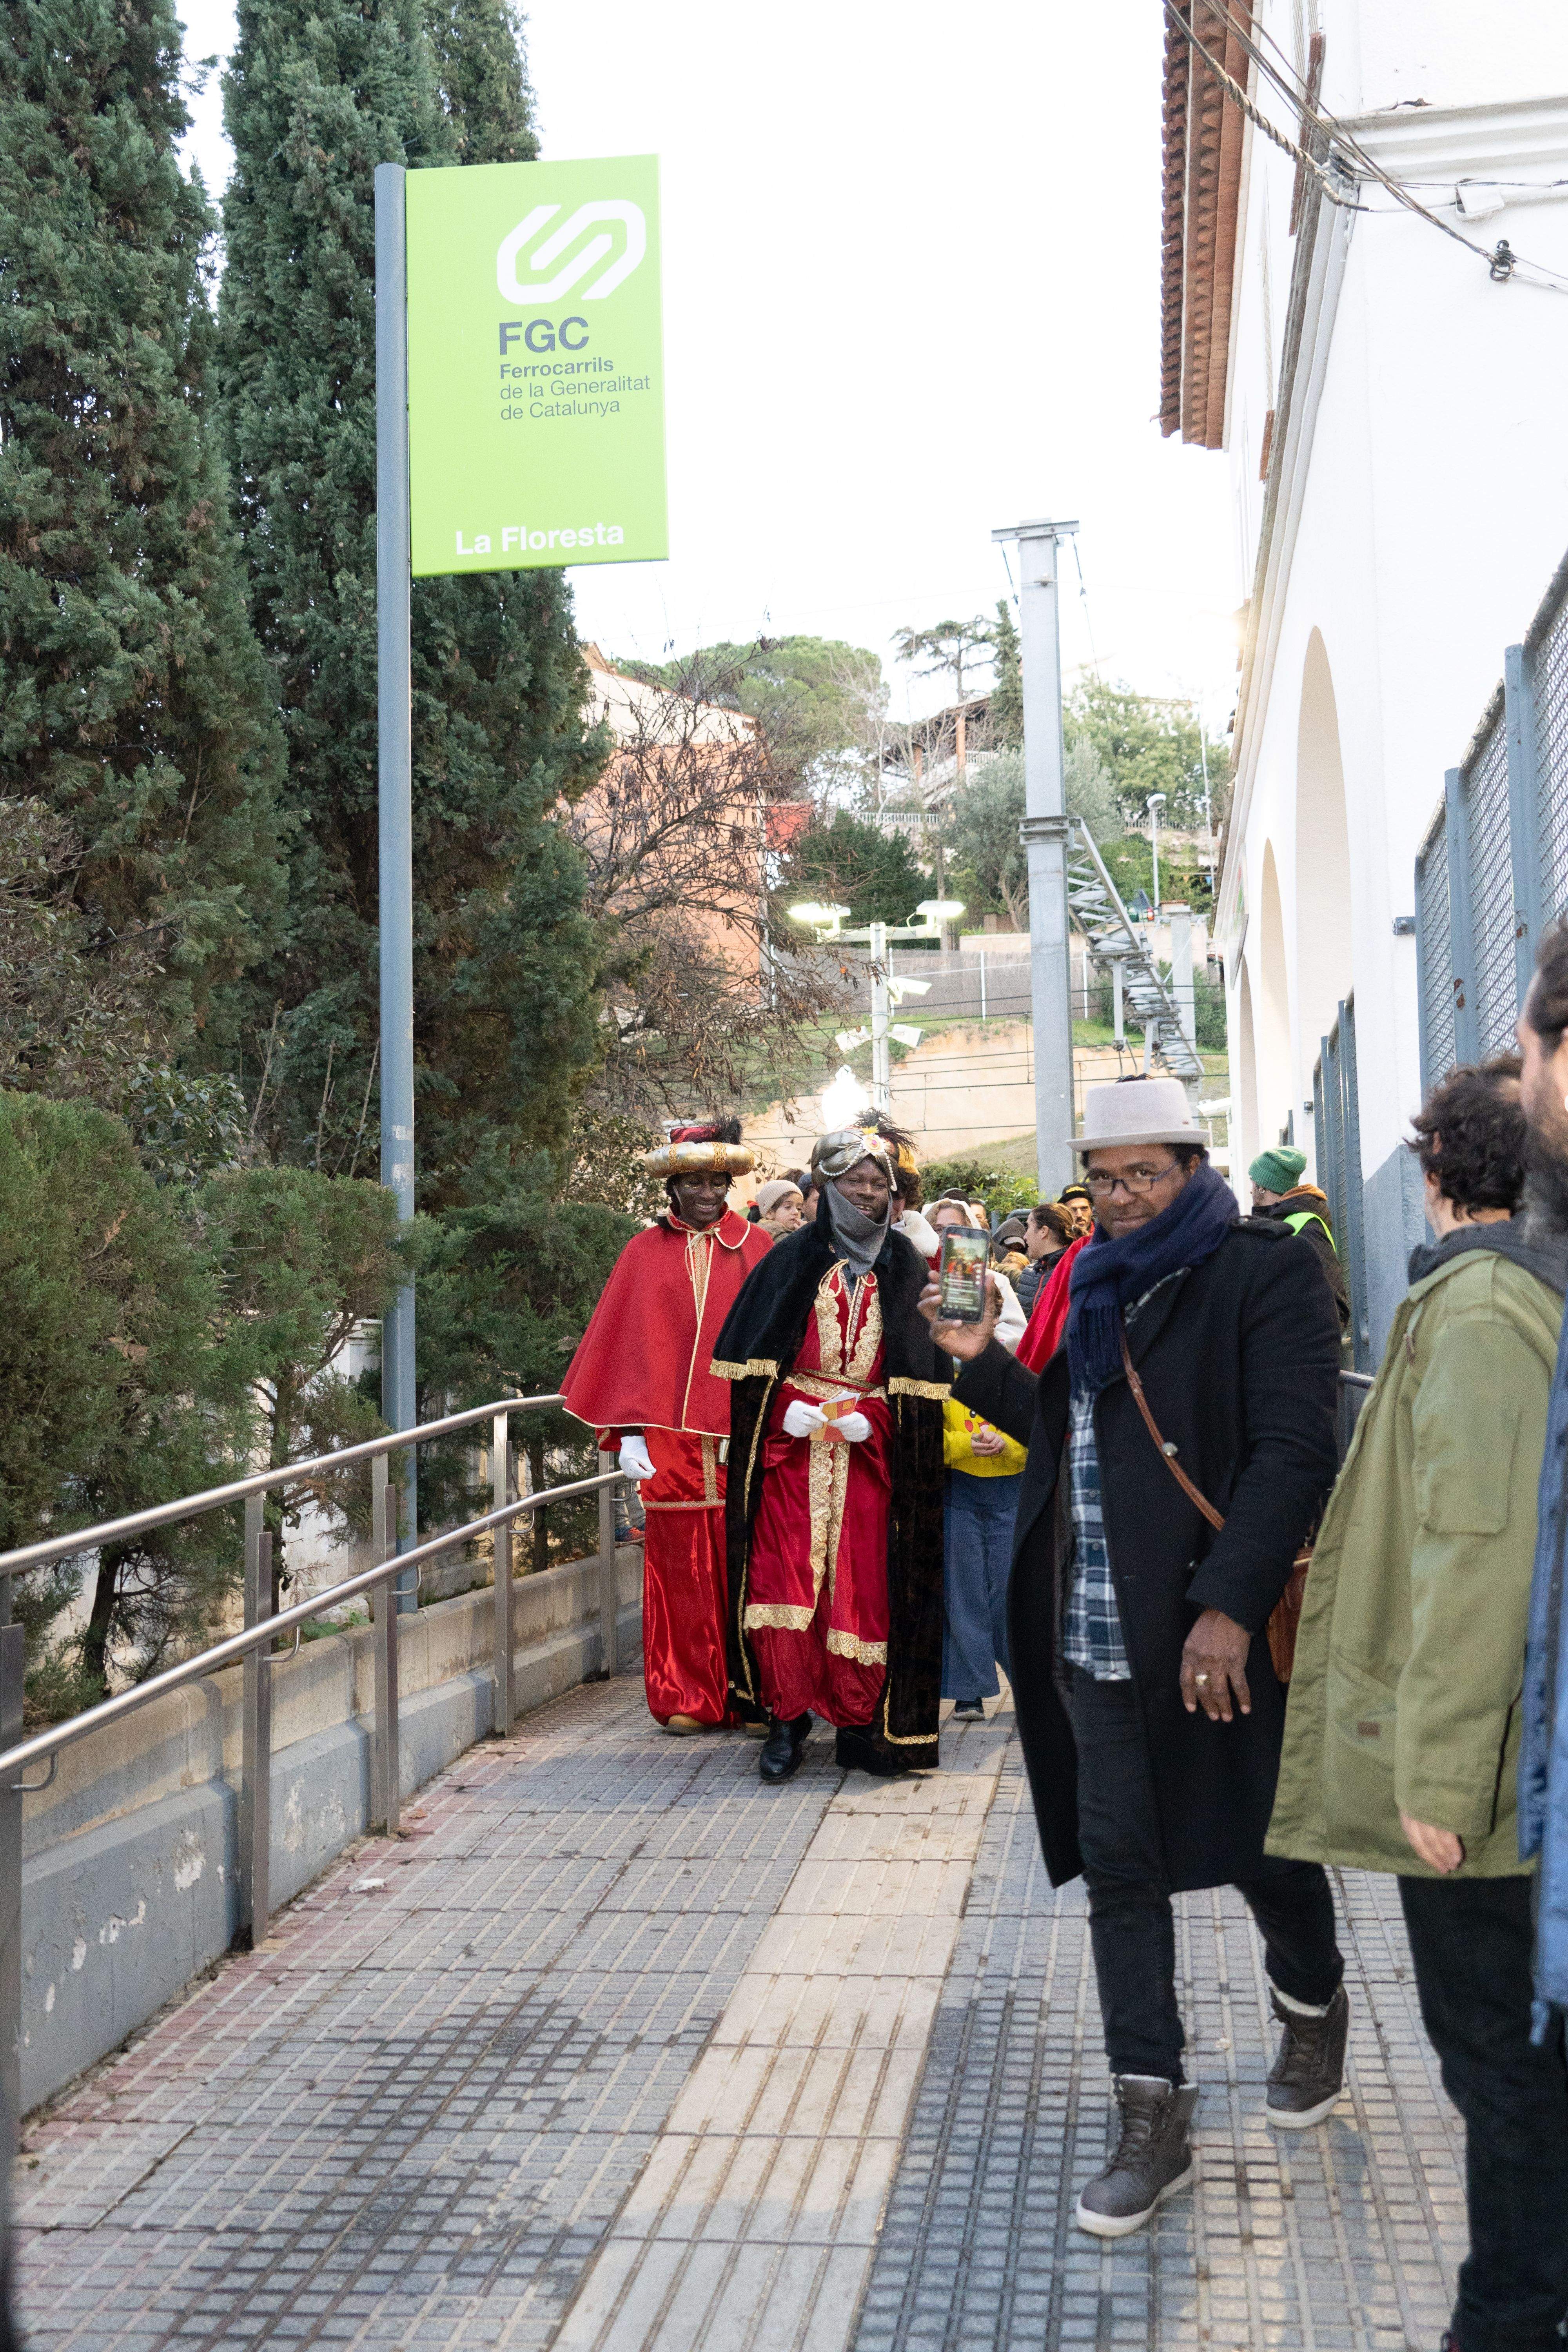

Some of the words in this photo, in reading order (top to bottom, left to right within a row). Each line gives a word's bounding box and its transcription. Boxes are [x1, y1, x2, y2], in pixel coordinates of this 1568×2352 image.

[499, 316, 589, 355] FGC
[500, 357, 614, 379] Ferrocarrils
[500, 384, 523, 400] de
[529, 382, 544, 397] la
[550, 375, 650, 396] Generalitat
[500, 405, 523, 420] de
[529, 399, 620, 418] Catalunya
[456, 531, 491, 555] La
[502, 522, 624, 552] Floresta
